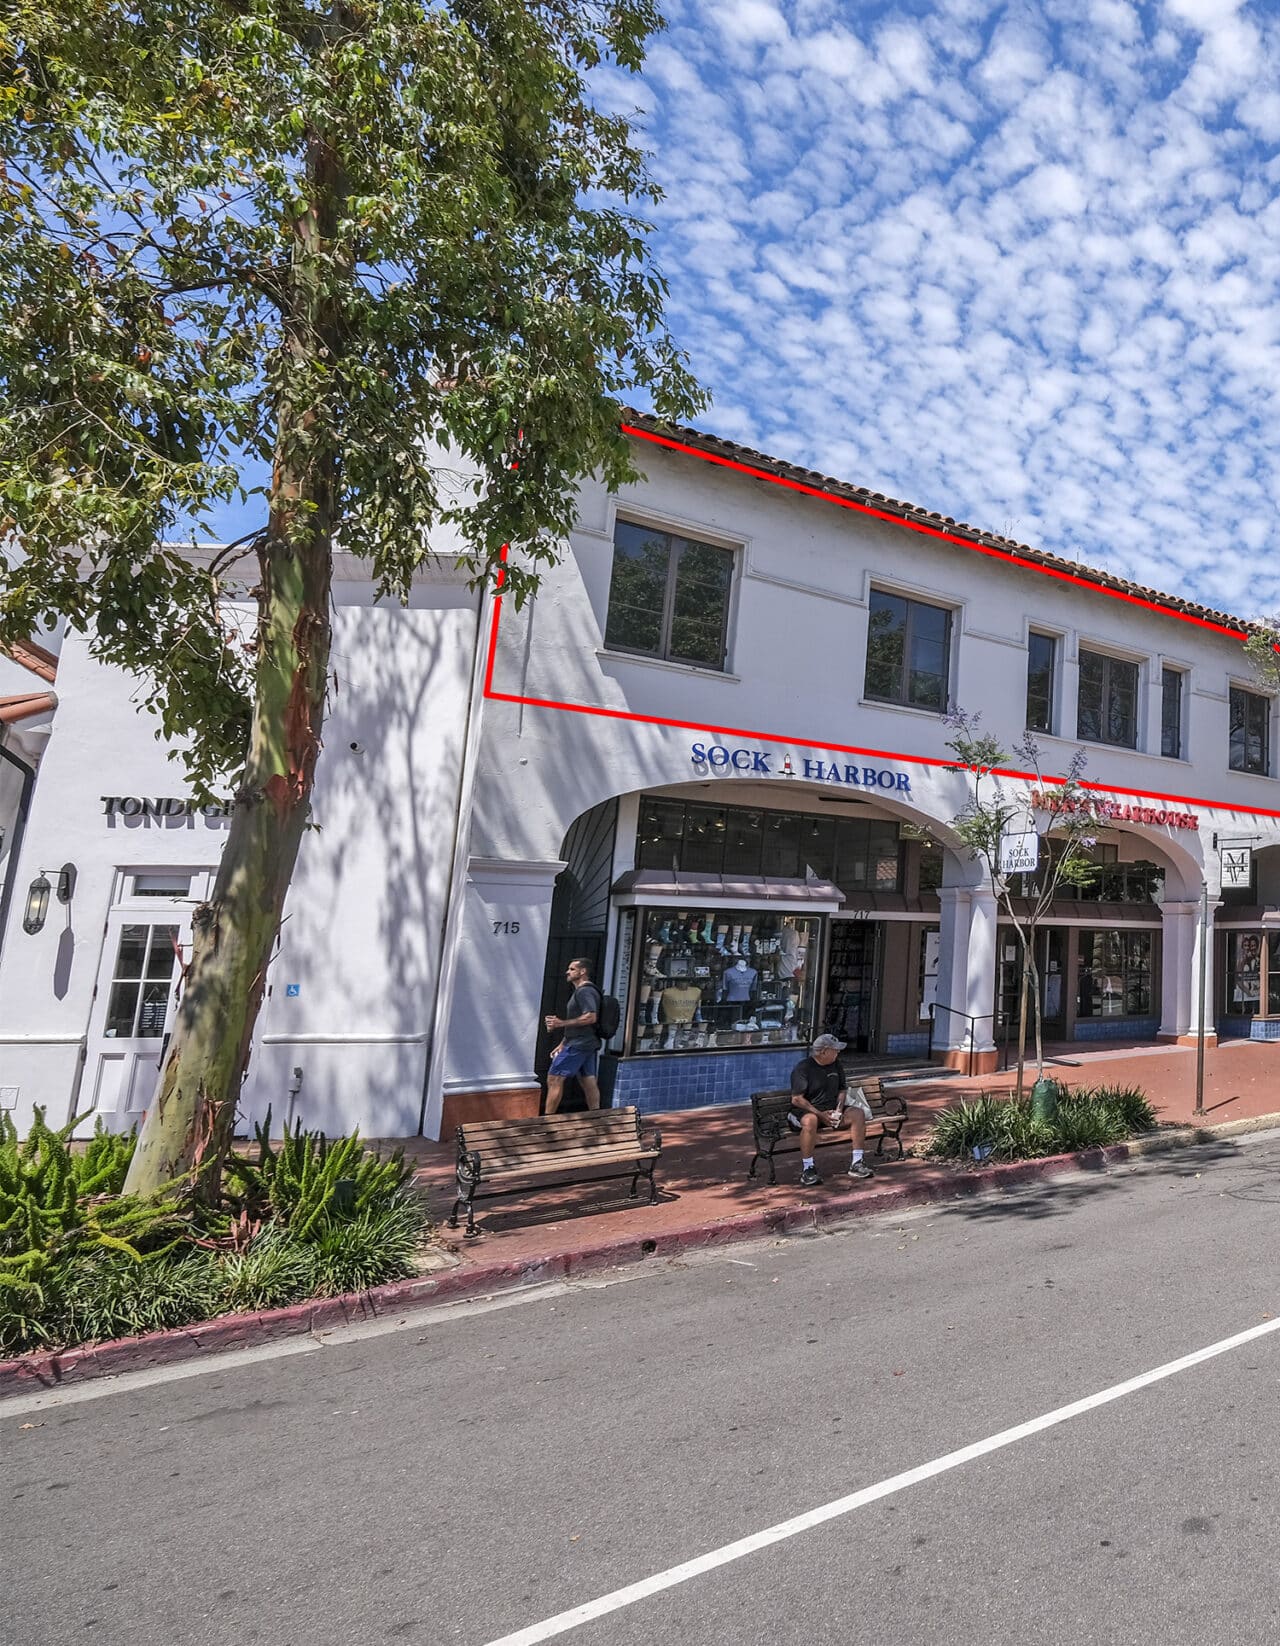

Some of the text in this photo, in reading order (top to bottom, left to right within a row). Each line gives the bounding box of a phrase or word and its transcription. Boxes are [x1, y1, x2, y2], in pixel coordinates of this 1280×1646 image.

[691, 743, 912, 791] SOCK HARBOR
[101, 797, 194, 816] TONDI
[1009, 848, 1029, 857] SOCK
[1002, 858, 1035, 869] HARBOR
[493, 921, 520, 934] 715
